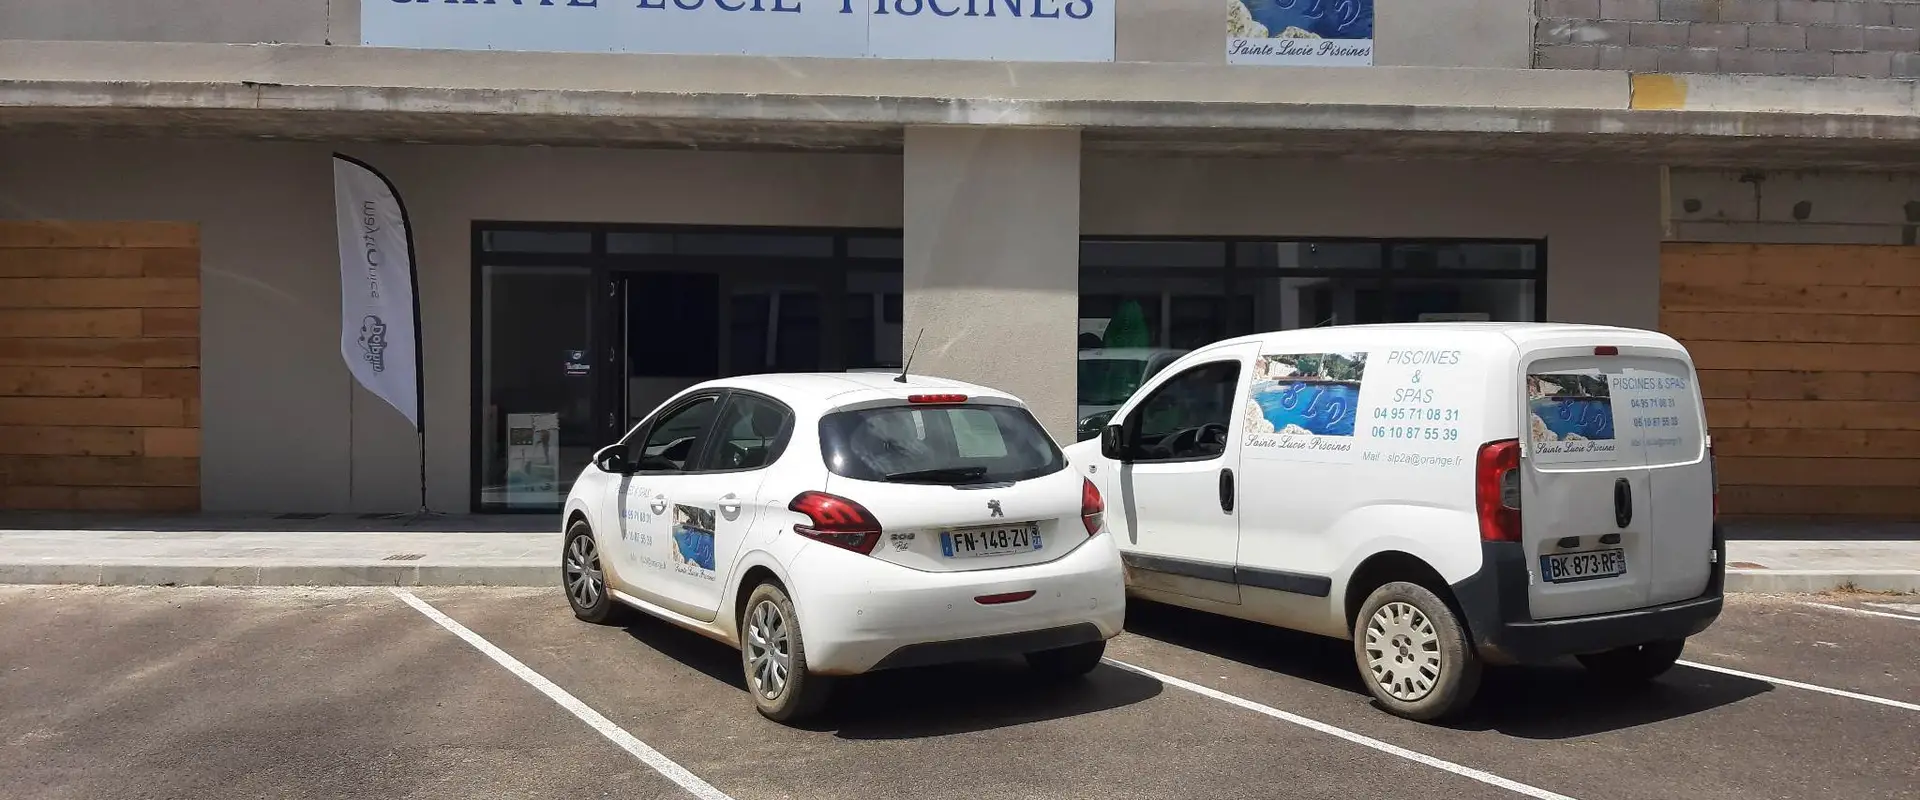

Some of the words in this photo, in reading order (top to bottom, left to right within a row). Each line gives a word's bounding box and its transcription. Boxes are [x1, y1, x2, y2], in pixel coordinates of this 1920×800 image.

[1229, 40, 1273, 55] Sainte
[1276, 40, 1313, 56] Lucie
[1317, 40, 1371, 57] Piscines
[1387, 350, 1461, 365] PISCINES
[1411, 369, 1421, 384] &
[1613, 377, 1655, 390] PISCINES
[1393, 388, 1434, 404] SPAS
[1373, 407, 1387, 419] 04
[1391, 407, 1405, 420] 95
[1409, 408, 1422, 420] 71
[1426, 408, 1441, 421] 08
[1445, 409, 1459, 421] 31
[1371, 426, 1385, 438] 06
[1389, 426, 1403, 439] 10
[1406, 427, 1420, 439] 87
[1424, 427, 1439, 440] 55
[1443, 428, 1458, 441] 39
[1245, 434, 1277, 448] Sainte
[1278, 434, 1306, 449] Lucie
[1309, 437, 1352, 452] Piscines
[1536, 442, 1562, 454] Sainte
[1387, 452, 1463, 467] slp2a@orange.fr
[954, 528, 1028, 552] FN-148-ZV
[1551, 553, 1617, 577] BK-873-RF
